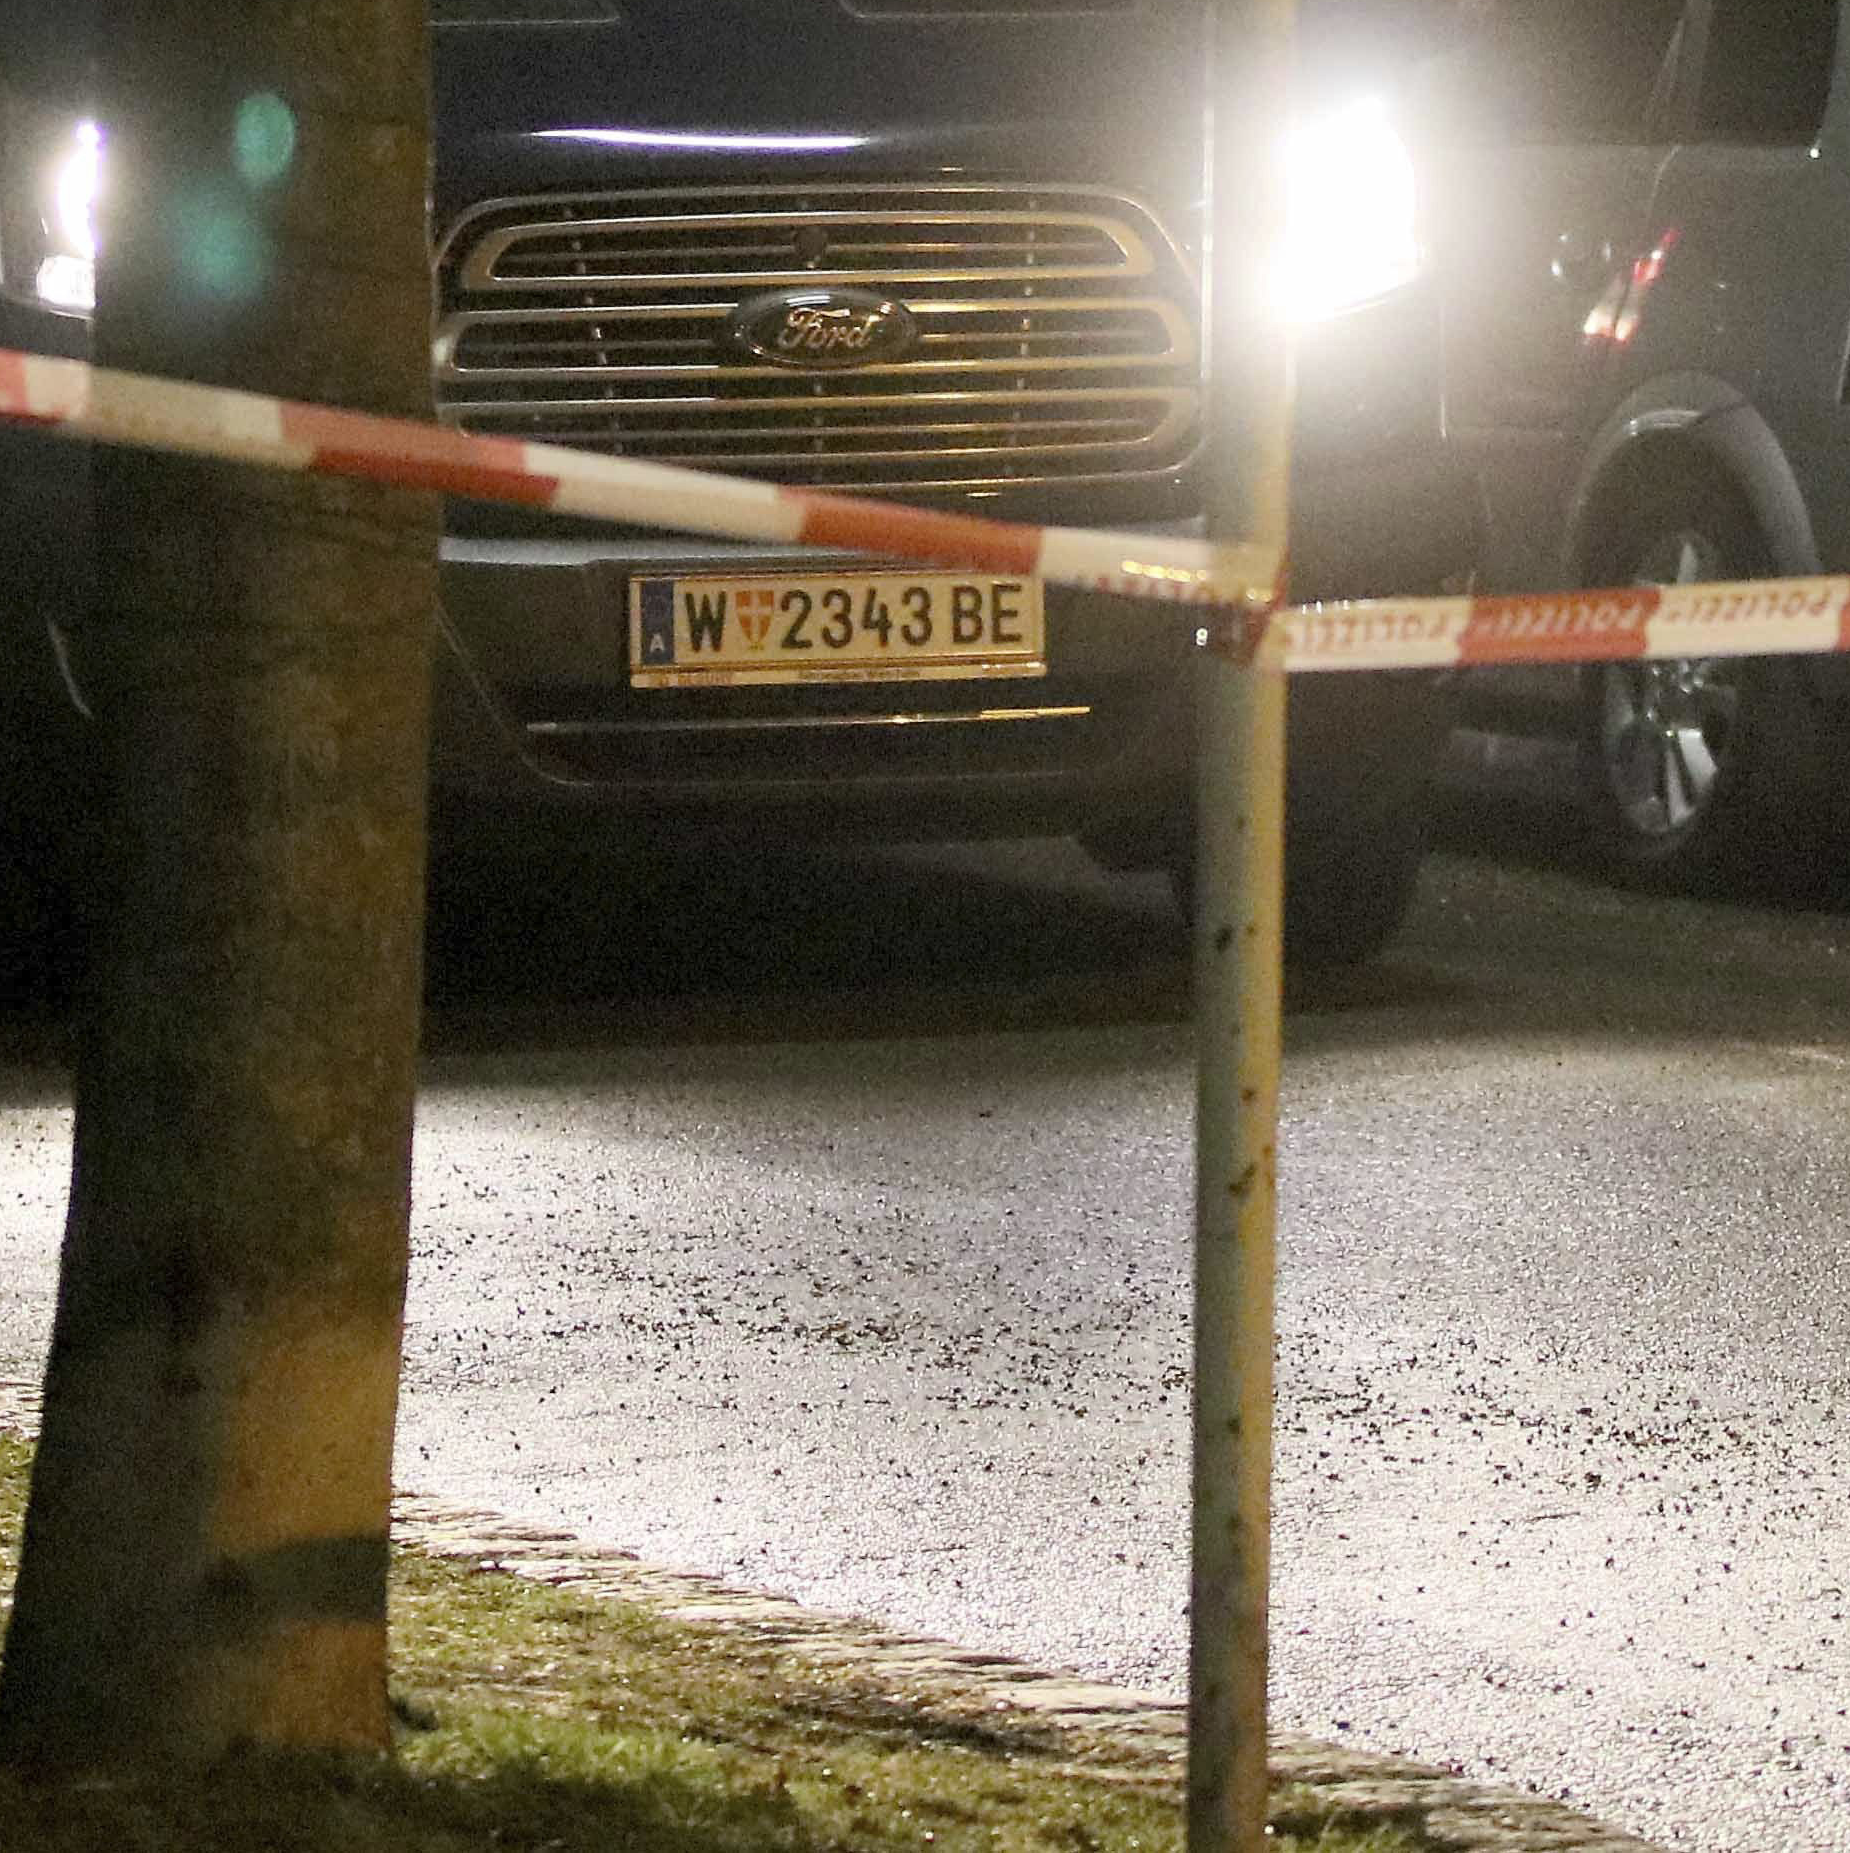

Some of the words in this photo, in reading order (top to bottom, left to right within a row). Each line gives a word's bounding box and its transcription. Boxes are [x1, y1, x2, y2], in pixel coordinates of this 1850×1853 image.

[685, 590, 727, 654] W
[780, 585, 934, 650] 2343
[951, 582, 1023, 646] BE
